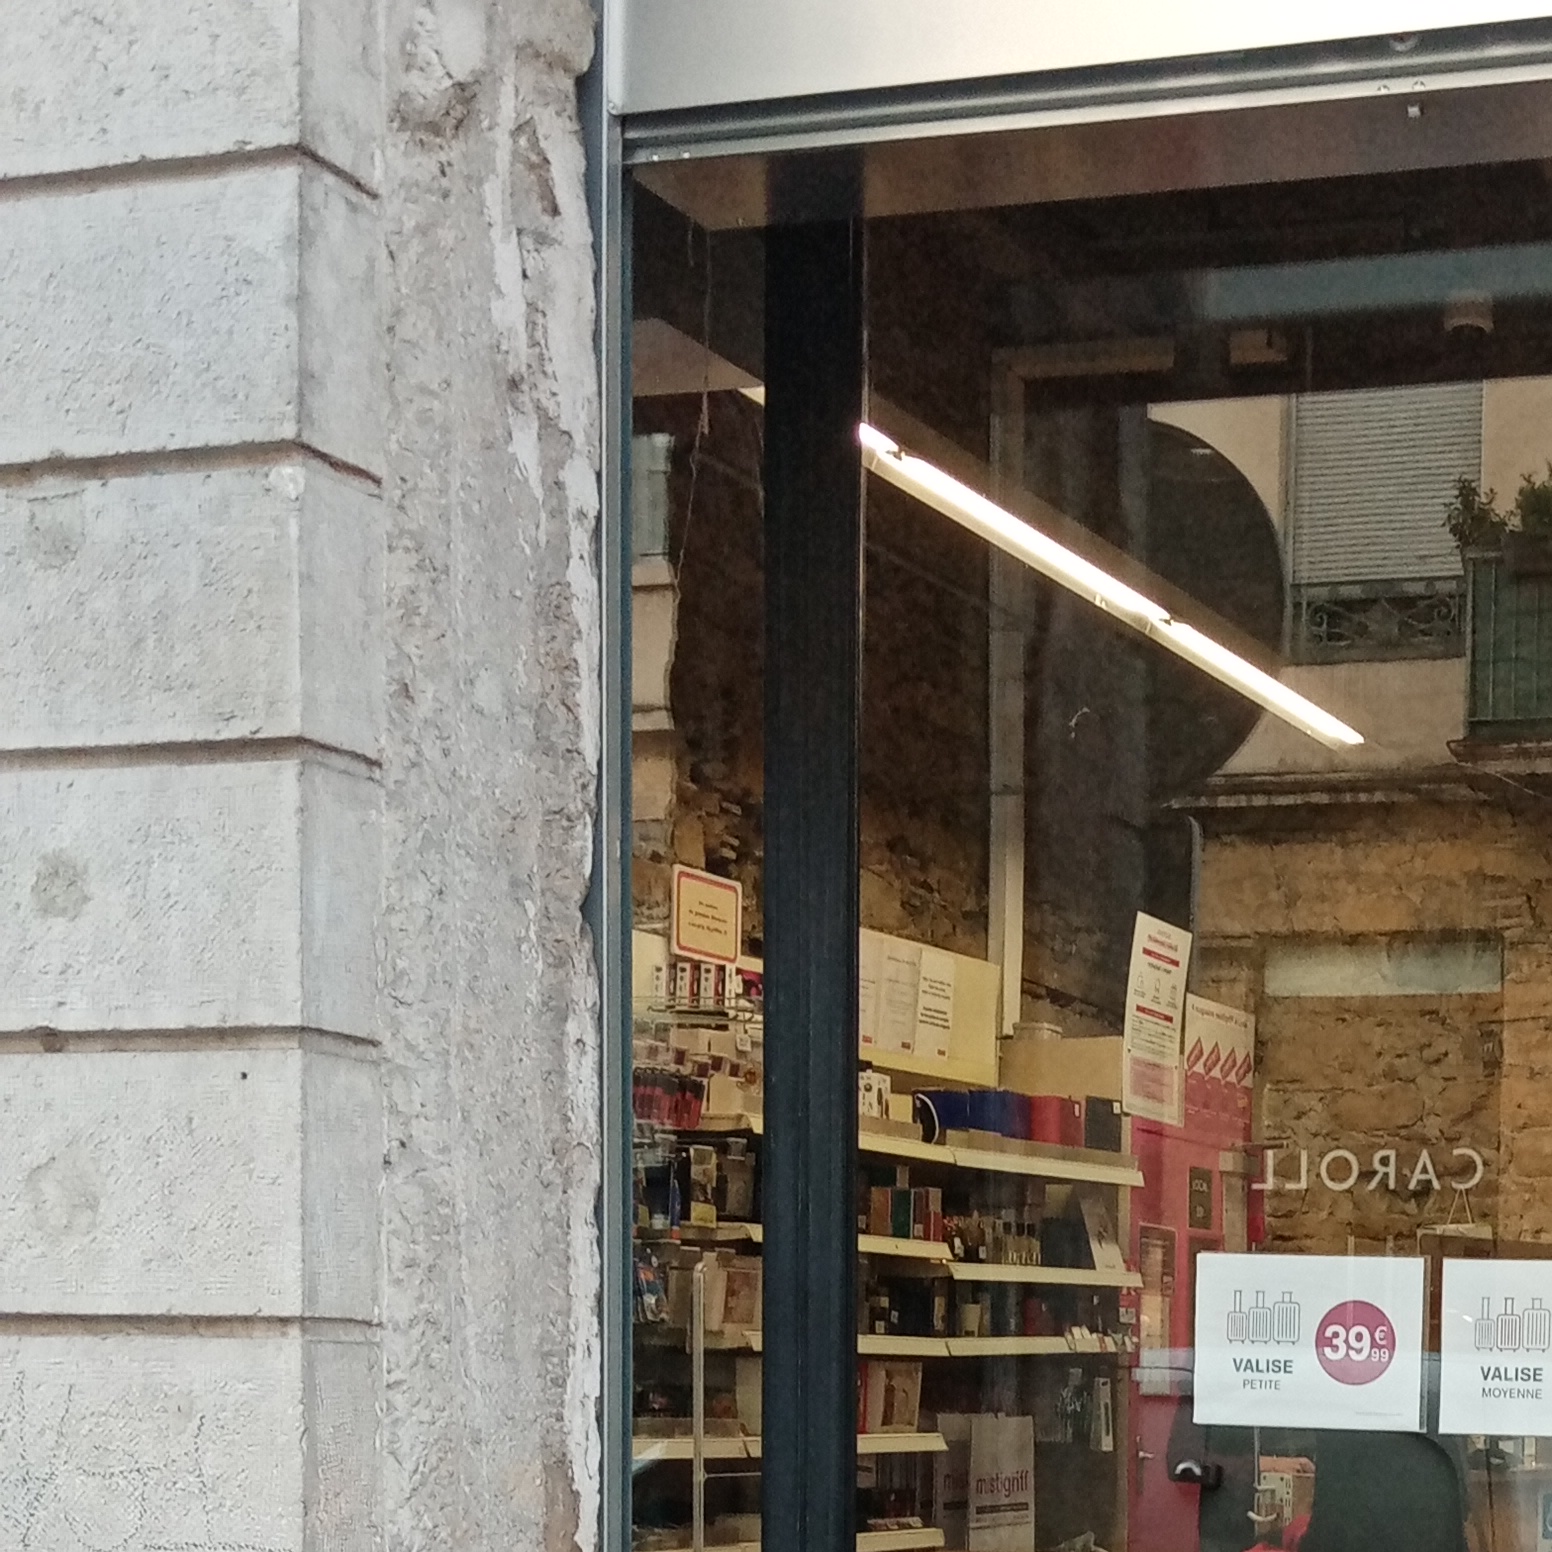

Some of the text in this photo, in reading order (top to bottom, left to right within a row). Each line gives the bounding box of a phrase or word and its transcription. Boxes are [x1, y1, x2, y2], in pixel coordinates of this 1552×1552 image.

[1232, 1358, 1294, 1375] VALISE
[1480, 1366, 1544, 1383] VALISE
[1242, 1379, 1282, 1391] PETITE
[1481, 1387, 1543, 1400] MOYENNE
